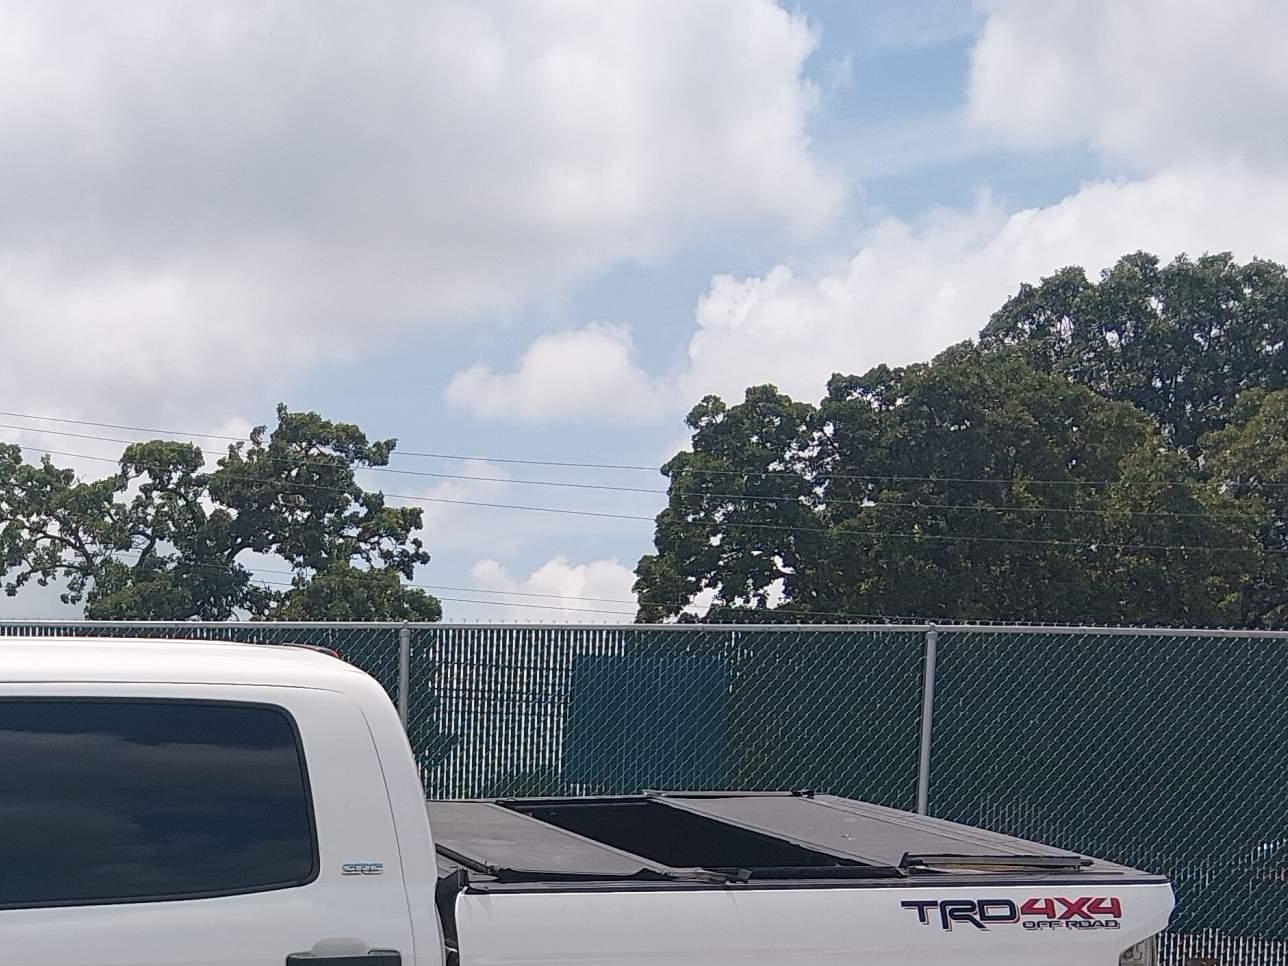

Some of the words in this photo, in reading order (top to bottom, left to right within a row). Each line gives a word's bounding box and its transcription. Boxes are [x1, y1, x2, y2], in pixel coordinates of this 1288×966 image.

[900, 899, 1021, 931] TRD
[1022, 920, 1062, 930] OFF
[1064, 919, 1121, 930] ROAD
